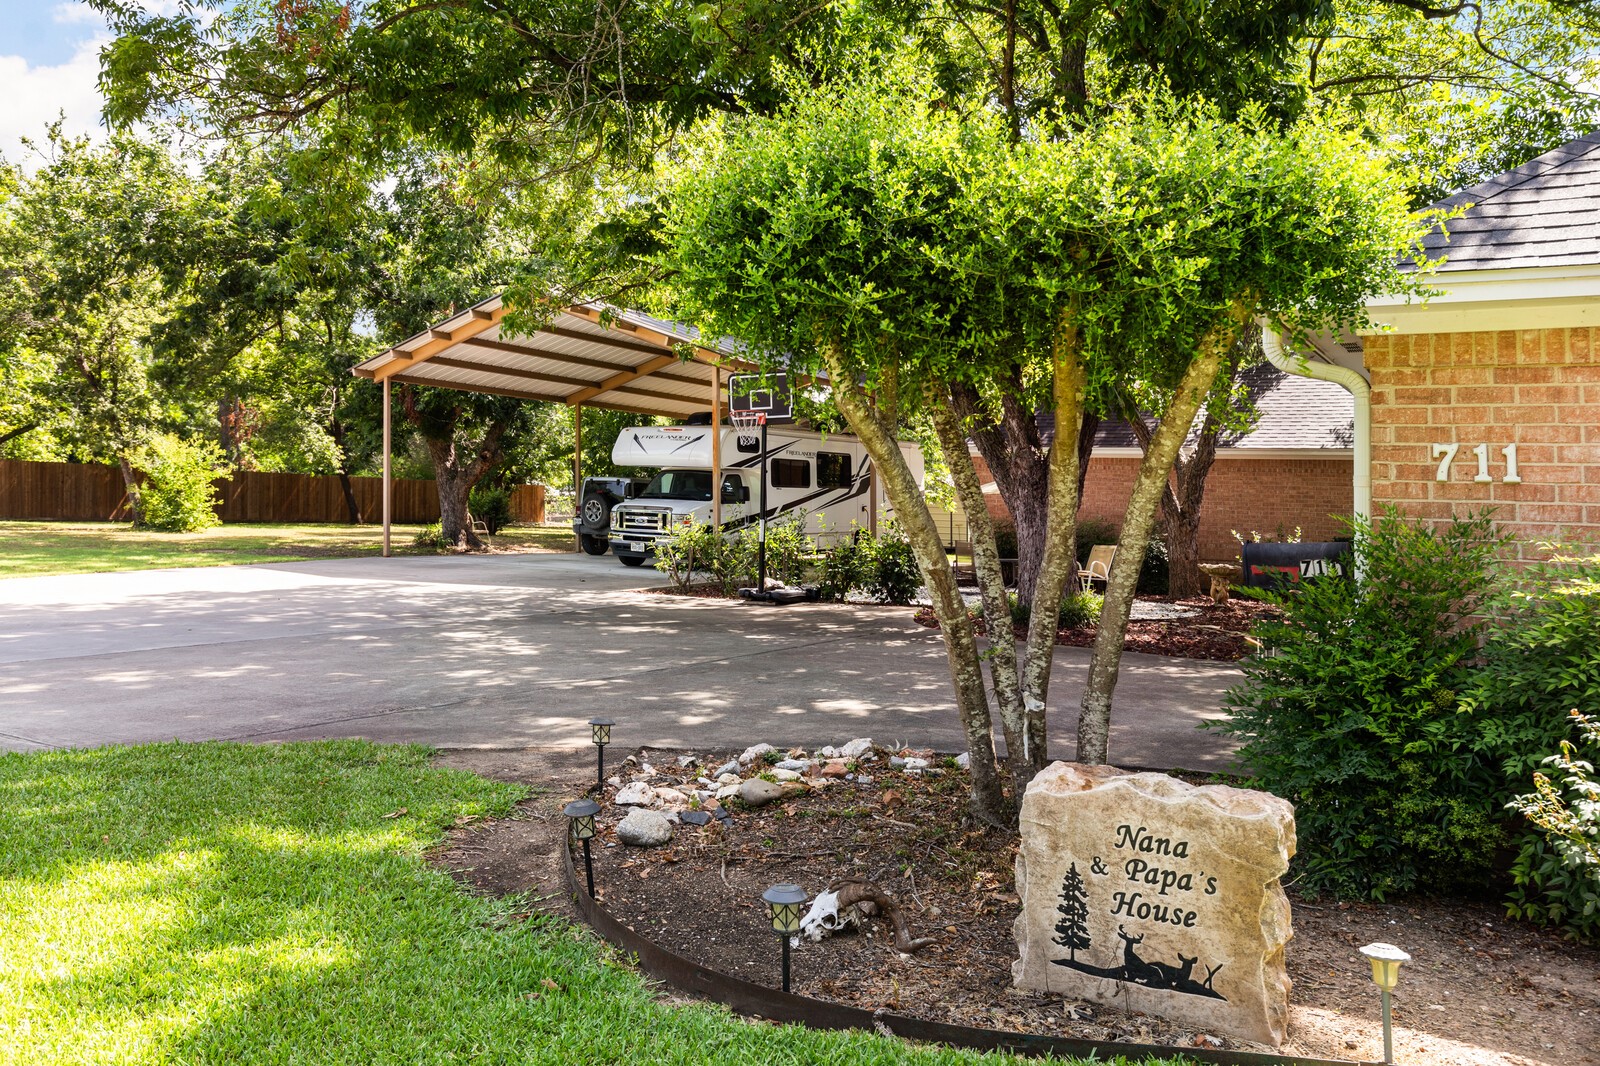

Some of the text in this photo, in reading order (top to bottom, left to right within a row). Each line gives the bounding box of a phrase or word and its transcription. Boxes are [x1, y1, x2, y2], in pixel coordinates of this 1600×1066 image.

[1432, 442, 1521, 483] 711
[1114, 824, 1188, 858] Nana
[1090, 856, 1217, 895] & Papa's
[1110, 891, 1197, 927] House
